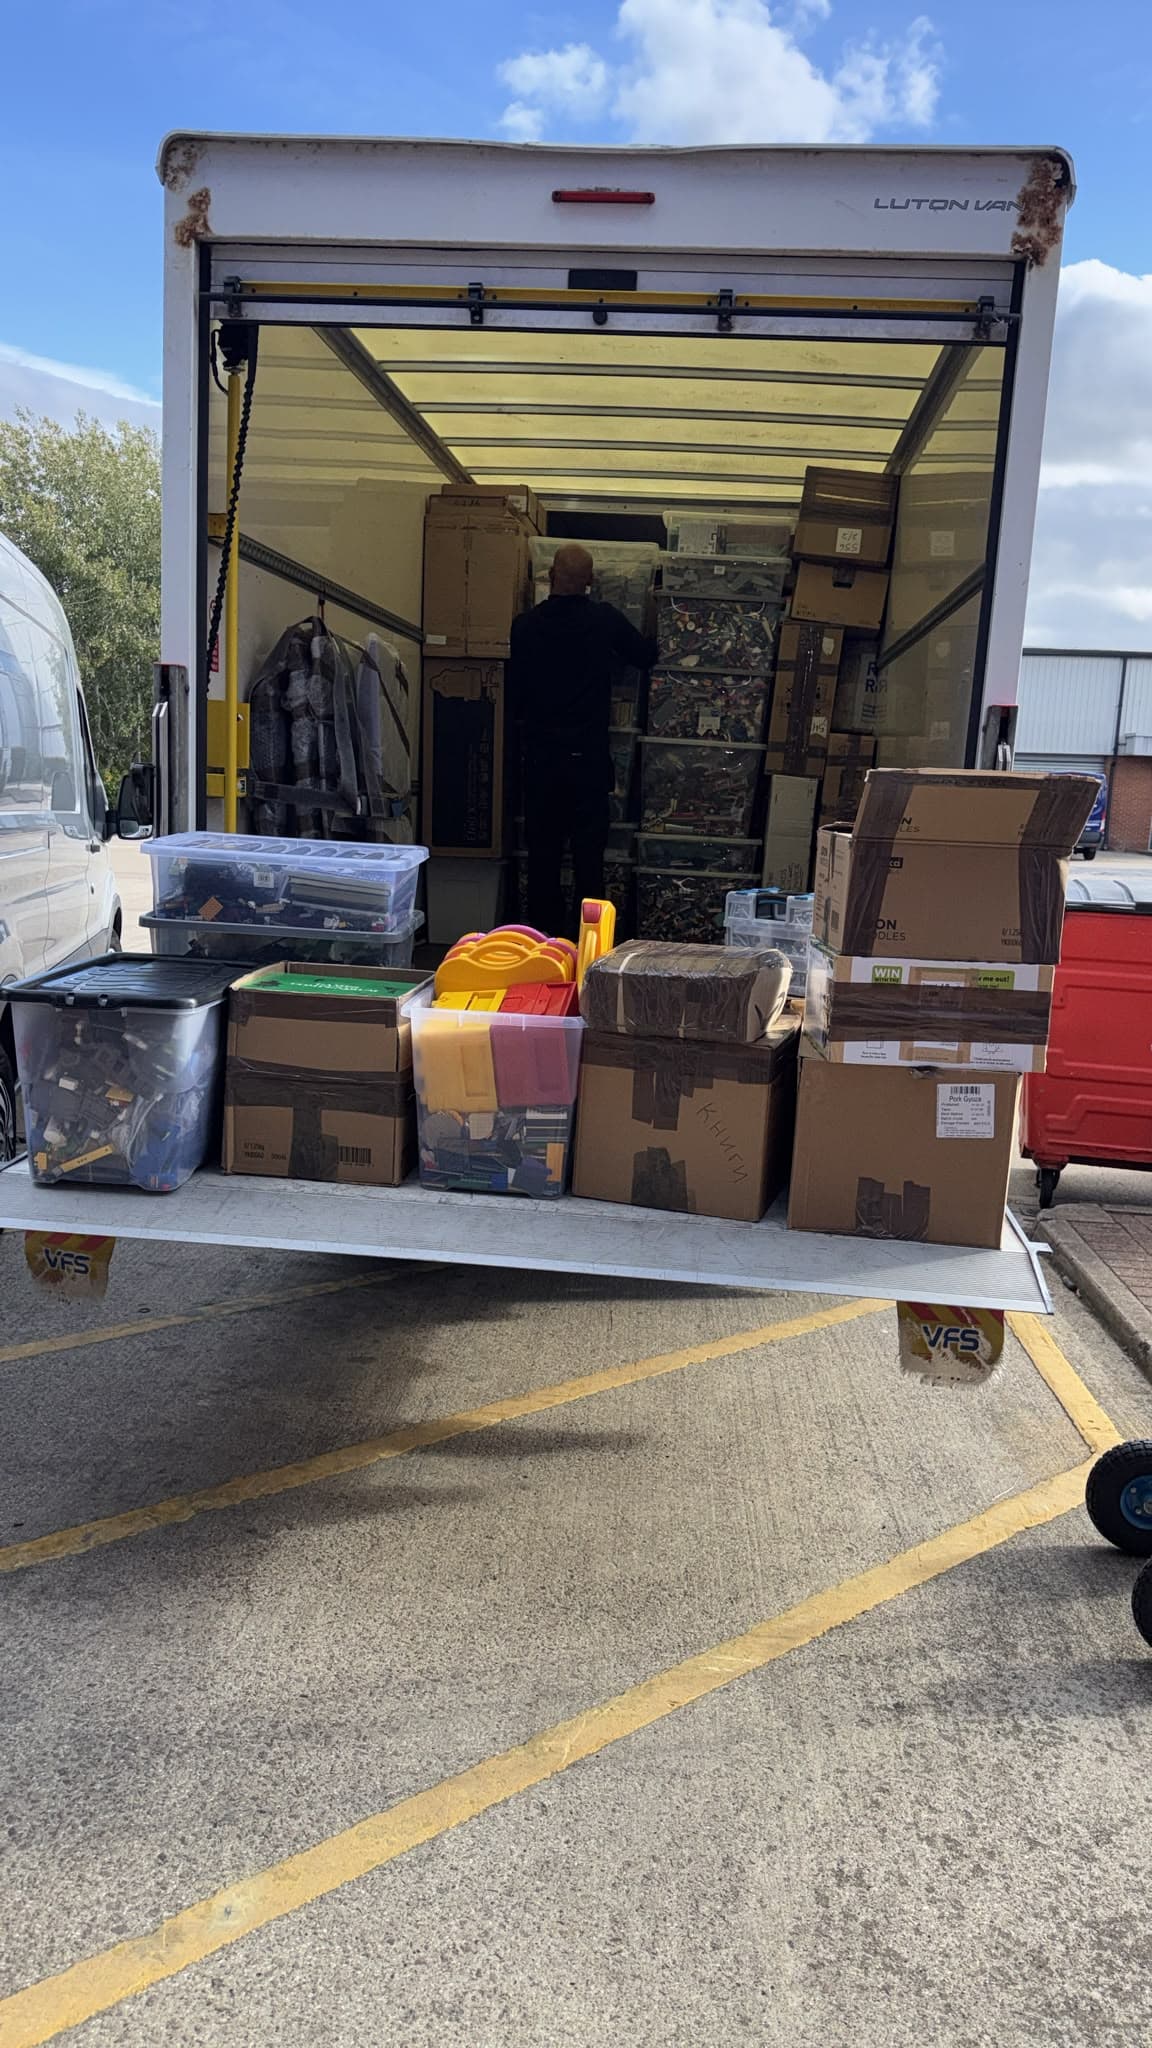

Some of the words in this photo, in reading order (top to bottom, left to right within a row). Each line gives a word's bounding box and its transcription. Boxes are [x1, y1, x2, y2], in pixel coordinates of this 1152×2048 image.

[874, 198, 970, 211] LUTON
[974, 199, 1025, 212] VAN
[875, 919, 897, 930] ON
[877, 931, 906, 941] DLES
[874, 967, 901, 978] WIN
[43, 1248, 91, 1275] VFS
[922, 1325, 980, 1352] VFS
